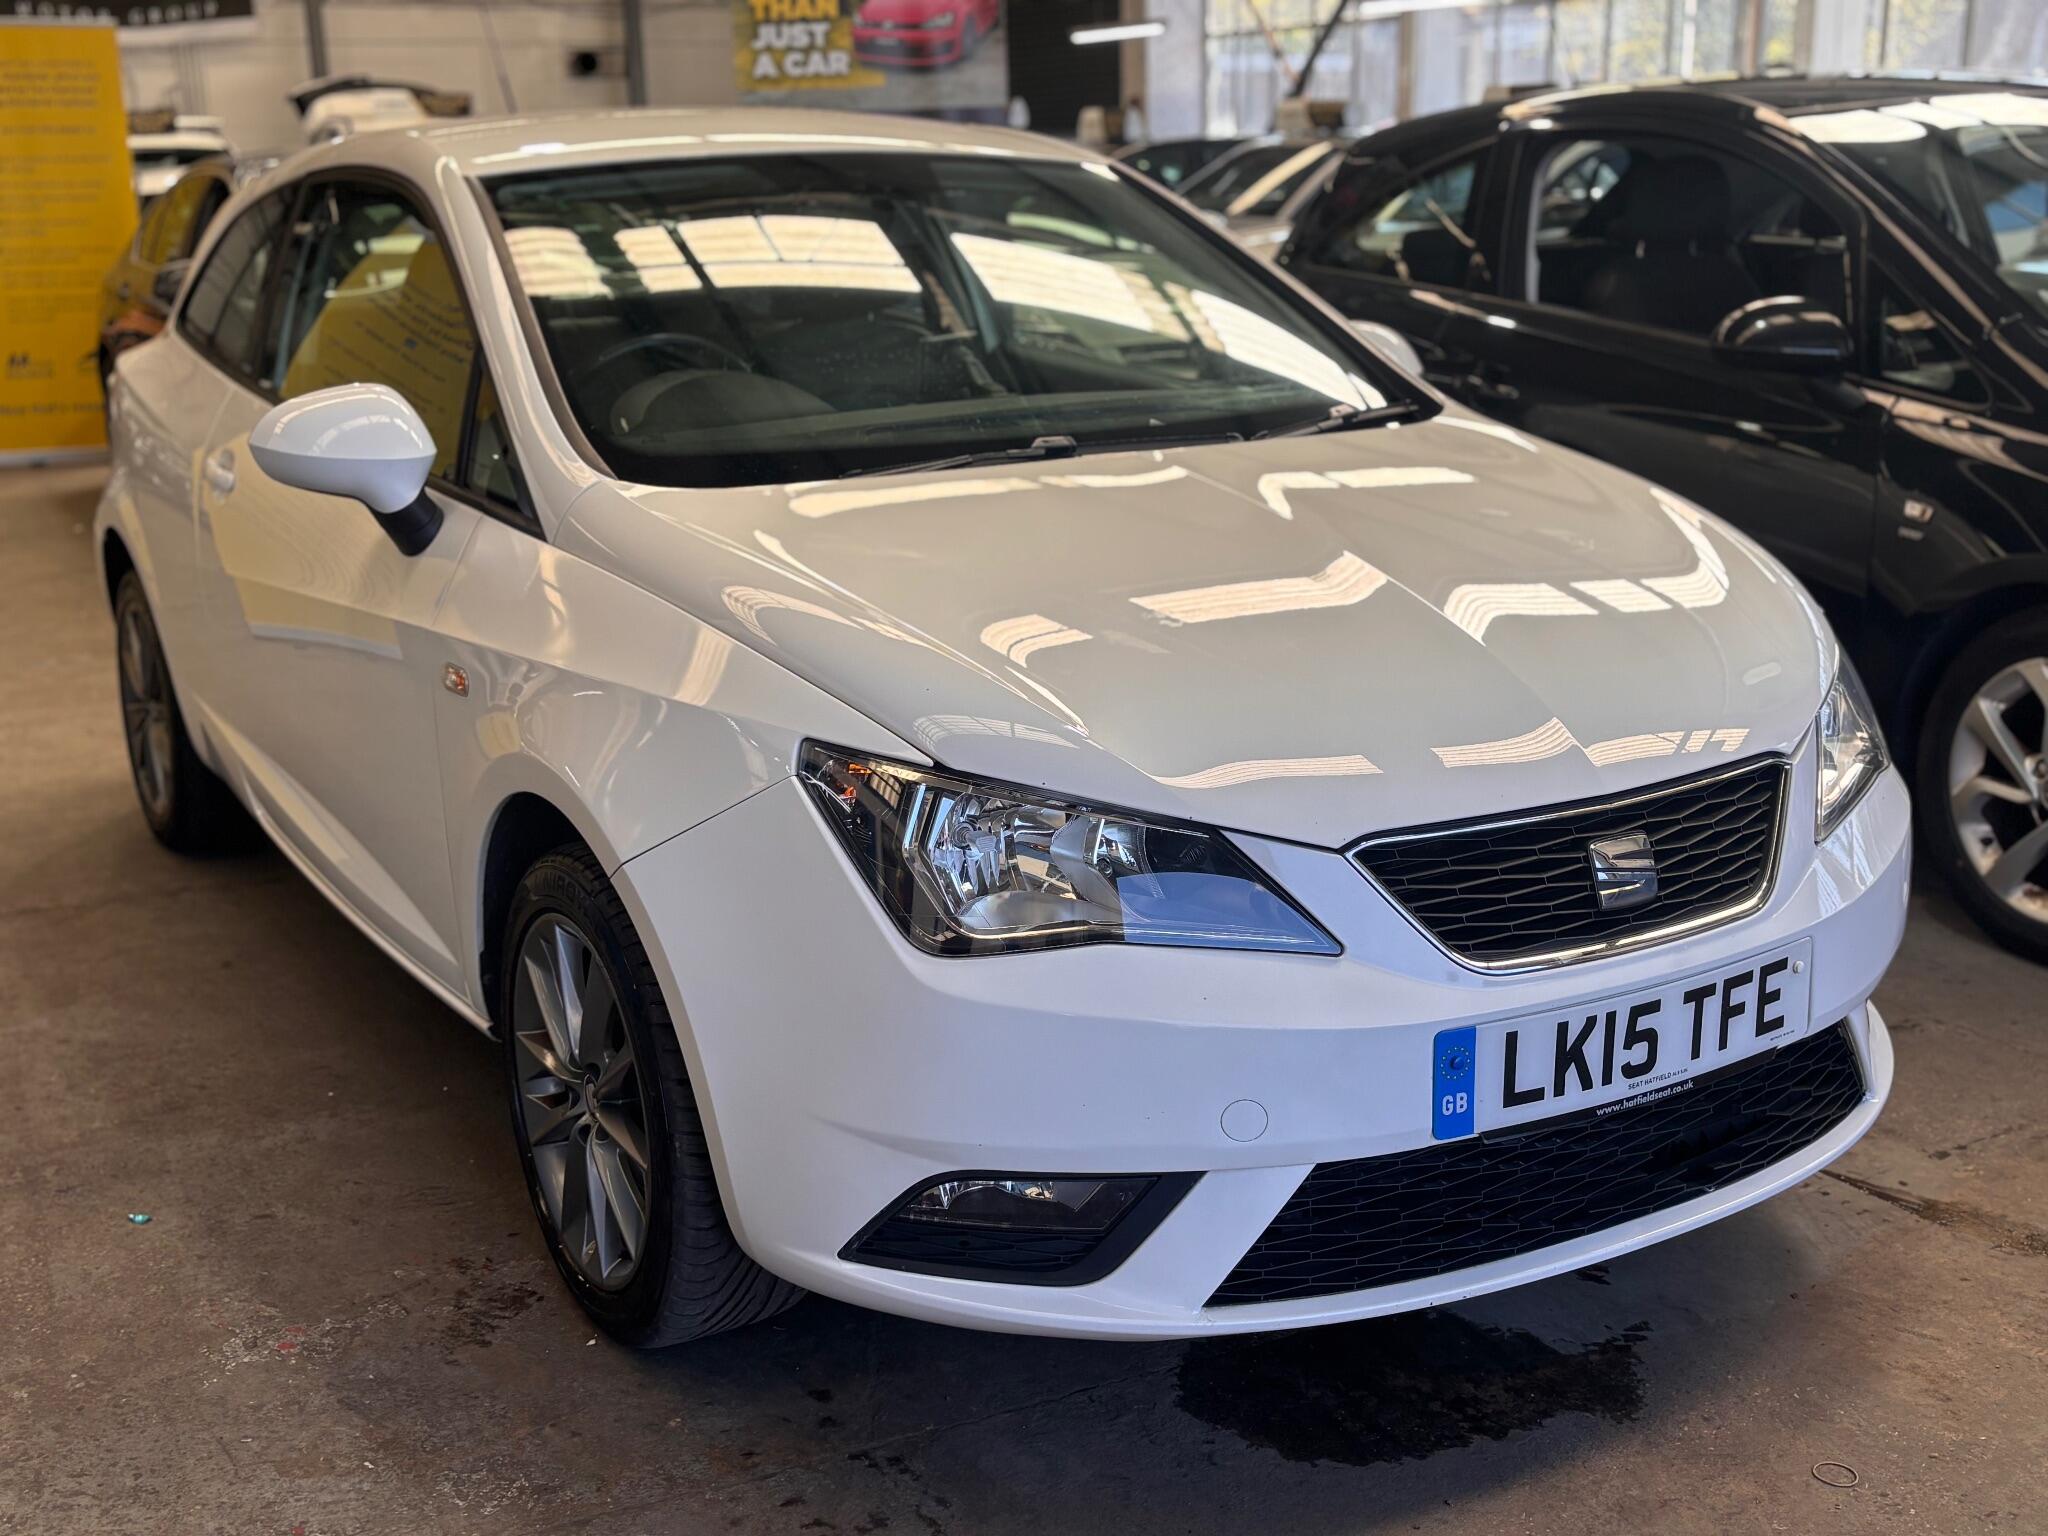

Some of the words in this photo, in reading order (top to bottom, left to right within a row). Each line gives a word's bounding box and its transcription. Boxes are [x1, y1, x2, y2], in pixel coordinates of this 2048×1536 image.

[127, 0, 218, 25] GROUP
[749, 0, 839, 20] THAN
[752, 21, 830, 49] JUST
[753, 52, 779, 79] A
[783, 51, 850, 77] CAR
[1502, 998, 1661, 1109] LK15
[1683, 956, 1789, 1061] TFE
[1628, 1080, 1643, 1090] SEAT
[1644, 1071, 1671, 1086] HATFIELD
[1442, 1092, 1468, 1116] GB
[1596, 1080, 1694, 1116] www.hatfieldseat.co.uk
